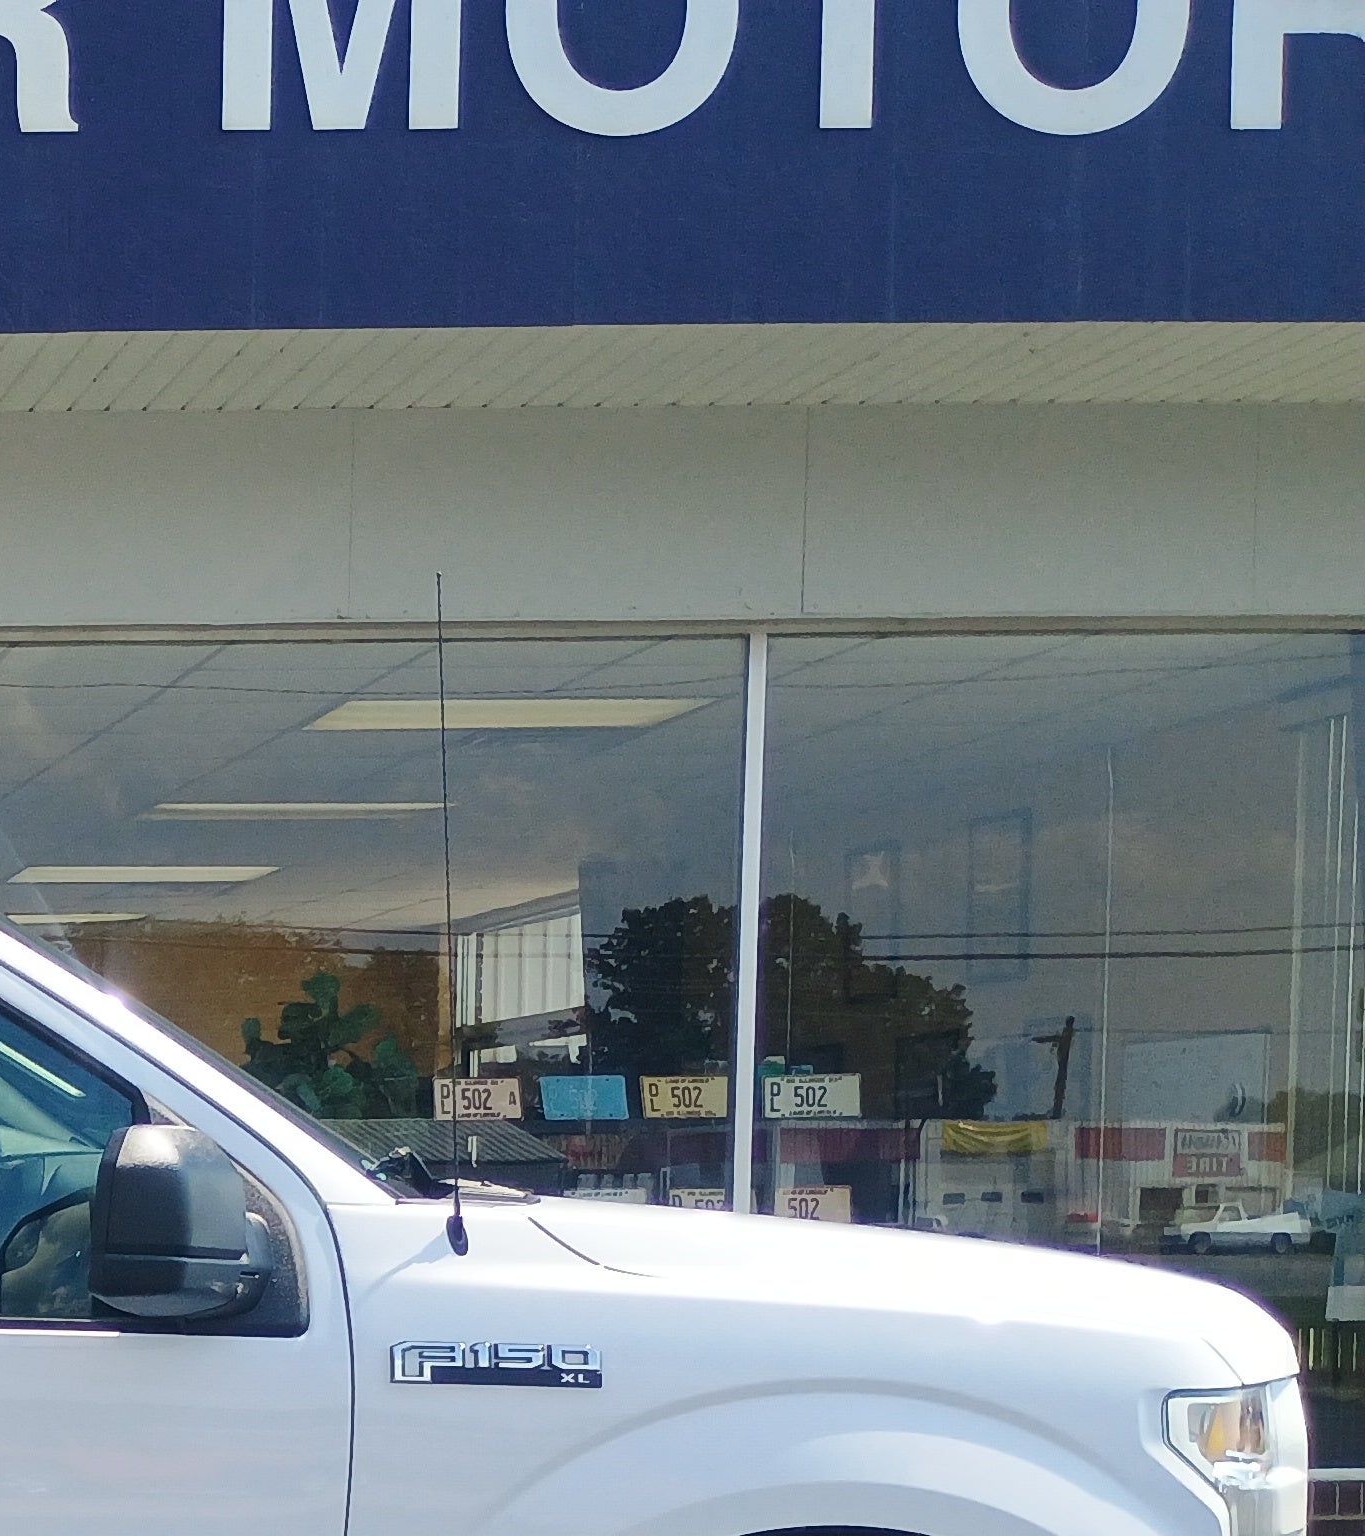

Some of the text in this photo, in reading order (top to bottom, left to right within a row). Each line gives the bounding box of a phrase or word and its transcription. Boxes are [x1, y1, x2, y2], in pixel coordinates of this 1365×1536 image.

[460, 1087, 493, 1111] 502
[670, 1085, 704, 1109] 502
[793, 1085, 828, 1108] 502
[787, 1197, 820, 1220] 502
[559, 1372, 591, 1385] XL
